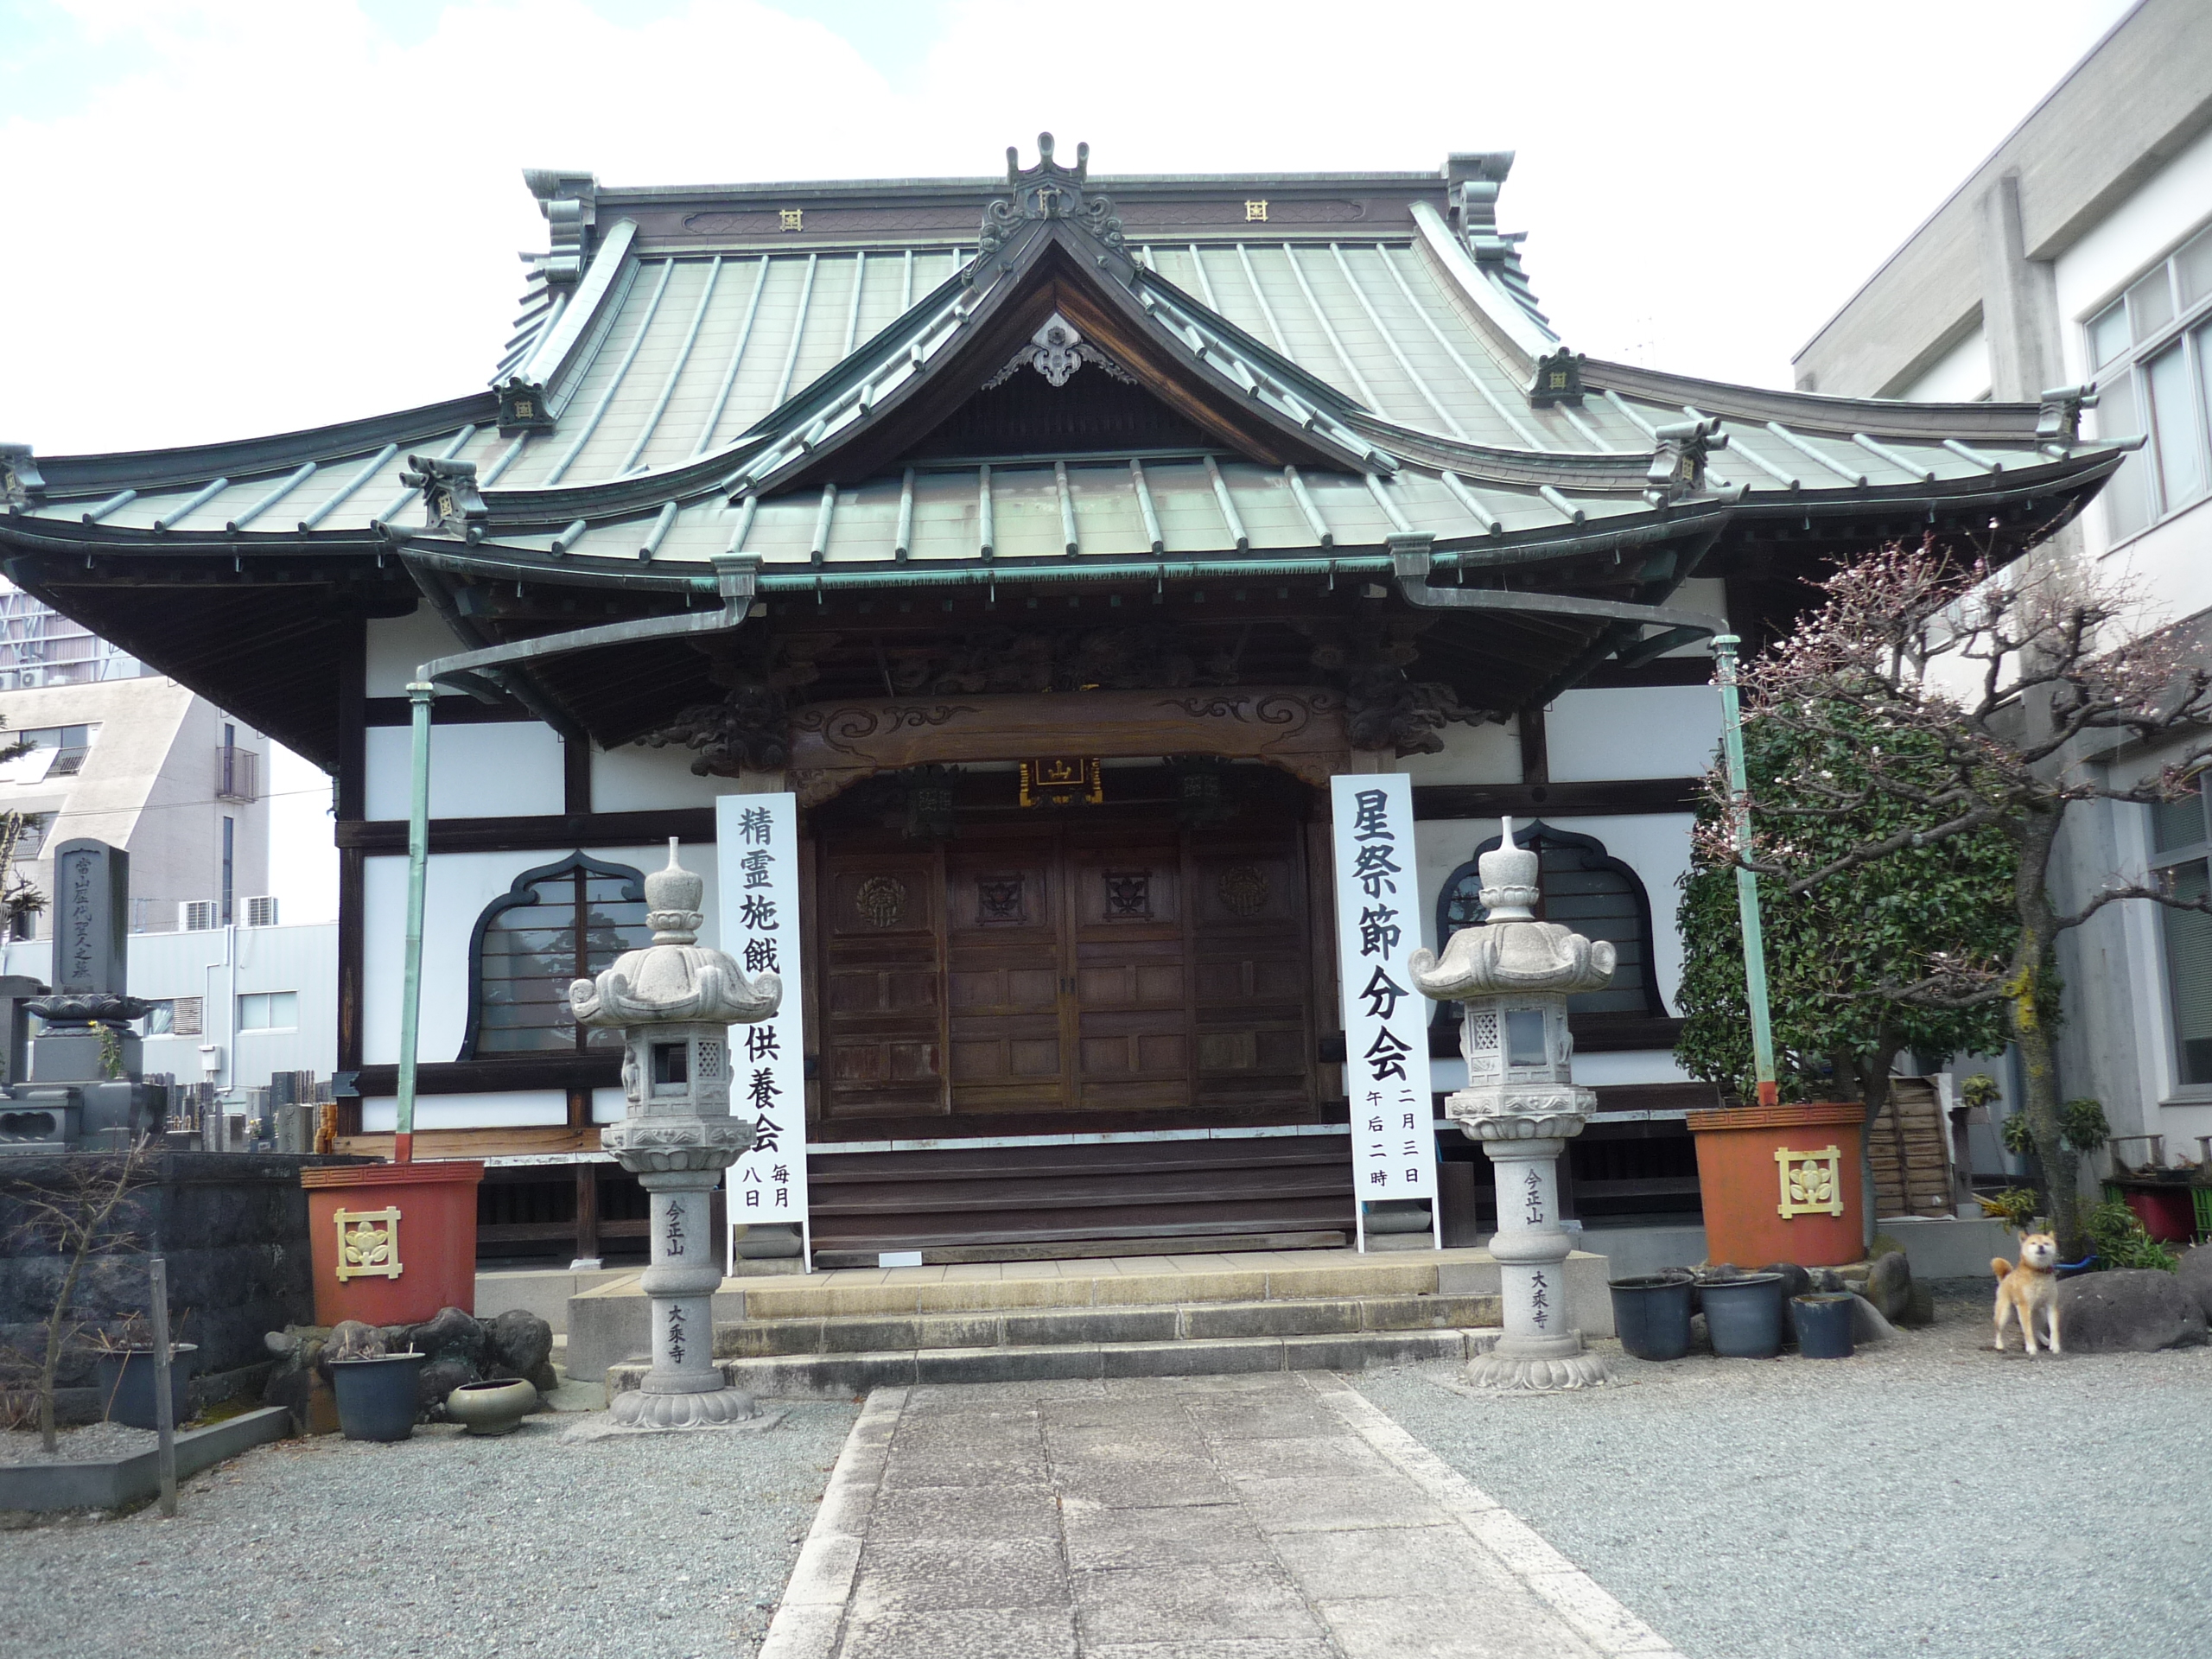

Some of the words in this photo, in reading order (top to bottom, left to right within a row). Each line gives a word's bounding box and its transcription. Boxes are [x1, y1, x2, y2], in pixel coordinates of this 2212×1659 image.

[1352, 788, 1414, 1082] 星祭節分会
[738, 806, 785, 1154] 精霊施餓供養会
[1365, 1090, 1388, 1187] 午后二時
[1398, 1089, 1419, 1184] 二月三日
[742, 1166, 762, 1209] 八日
[772, 1163, 790, 1209] 毎月
[1524, 1169, 1543, 1224] 今正山
[665, 1200, 685, 1257] 今正山
